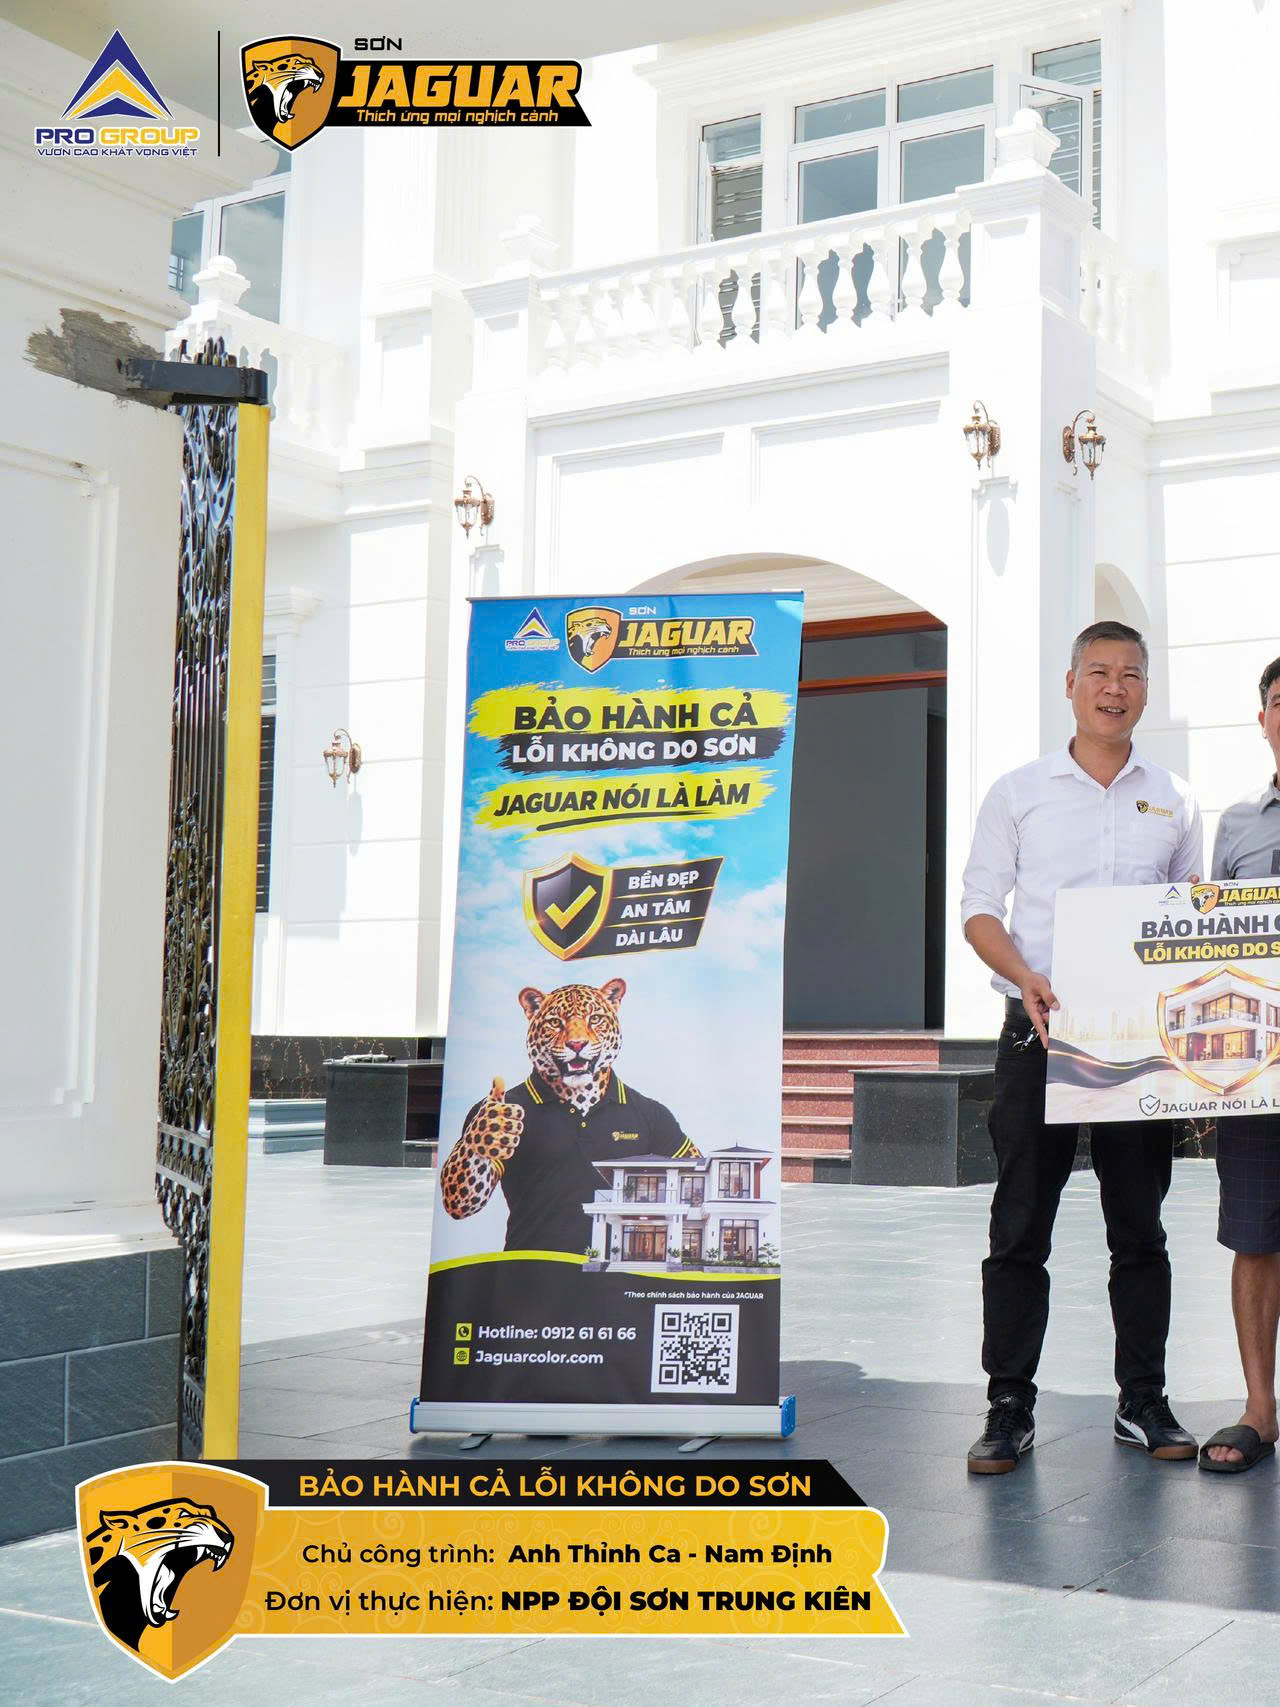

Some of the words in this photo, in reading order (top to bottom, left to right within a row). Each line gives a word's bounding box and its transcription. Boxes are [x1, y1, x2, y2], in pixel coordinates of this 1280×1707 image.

[618, 620, 752, 648] JAGUAR
[514, 697, 591, 731] BẢO
[602, 698, 699, 729] HÀNH
[710, 692, 758, 726] CẢ
[513, 737, 554, 763] LỖI
[562, 740, 655, 763] KHÔNG
[663, 739, 698, 759] DO
[703, 736, 756, 756] SƠN
[494, 791, 598, 817] JAGUAR
[604, 783, 649, 810] NÓI
[656, 782, 688, 808] LÀ
[696, 778, 750, 806] LÀM
[628, 870, 664, 890] BỀN
[667, 870, 700, 888] ĐẸP
[621, 903, 649, 919] AN
[651, 899, 690, 916] TÂM
[1142, 915, 1193, 939] BẢO
[1197, 913, 1269, 936] HÀNH
[615, 926, 645, 947] DÀI
[649, 926, 683, 944] LÂU
[1144, 943, 1172, 962] LỖI
[1175, 943, 1239, 960] KHÔNG
[1243, 943, 1269, 956] DO
[1162, 1101, 1217, 1113] JAGUAR
[1222, 1099, 1246, 1110] NÓI
[1251, 1097, 1268, 1109] LÀ
[478, 1325, 538, 1339] Hotline:
[542, 1327, 574, 1339] 0912
[579, 1327, 593, 1339] 61
[598, 1327, 612, 1340] 61
[617, 1327, 636, 1340] 66
[475, 1350, 604, 1366] Jaguarcolor.com
